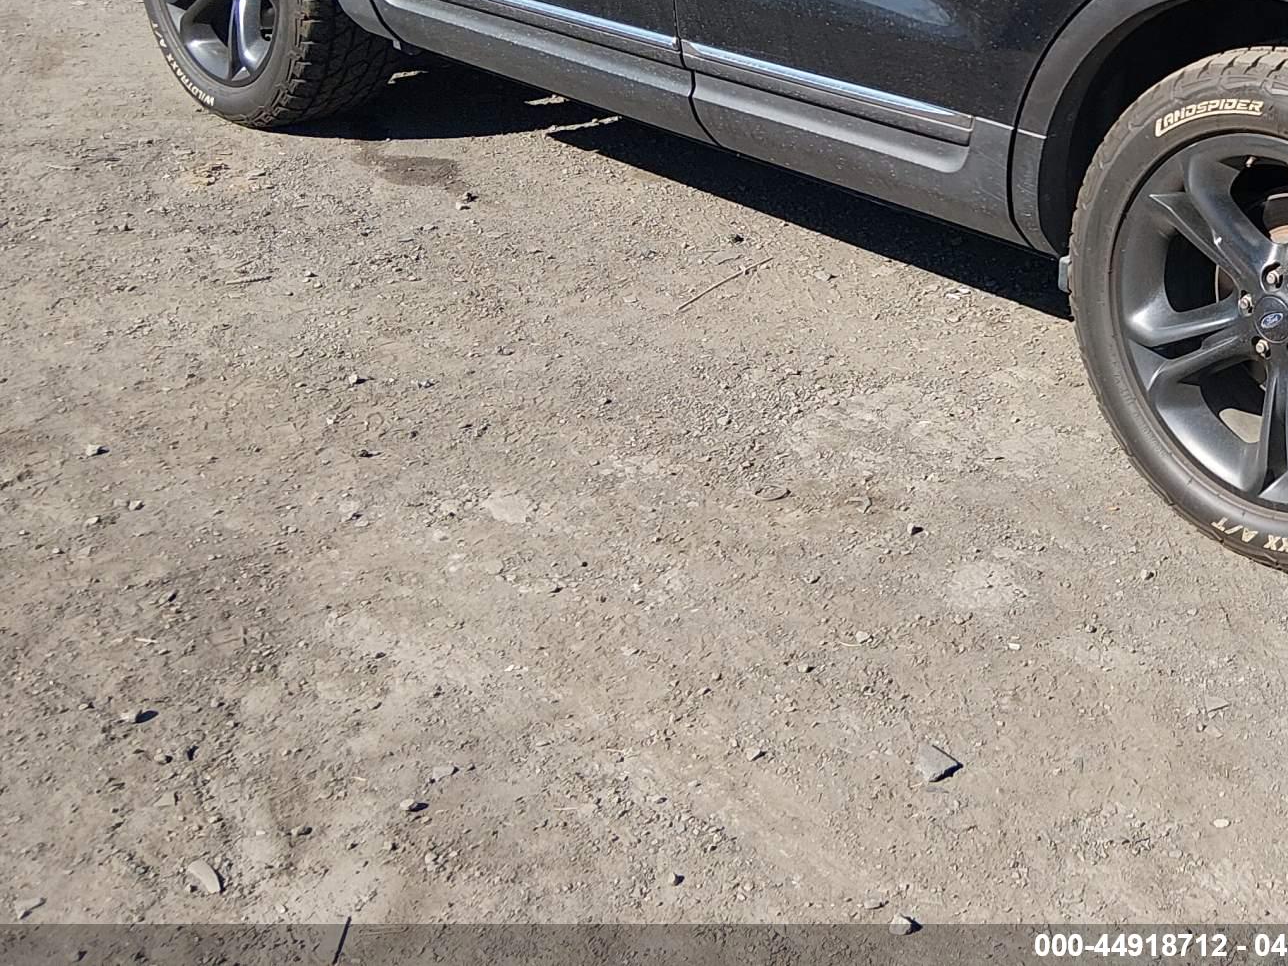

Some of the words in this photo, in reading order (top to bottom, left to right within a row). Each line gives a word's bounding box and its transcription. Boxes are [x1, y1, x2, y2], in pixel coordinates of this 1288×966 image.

[166, 53, 215, 107] WILDTRAXX
[1155, 98, 1264, 137] LANDSPIDER
[1211, 517, 1259, 543] A/T
